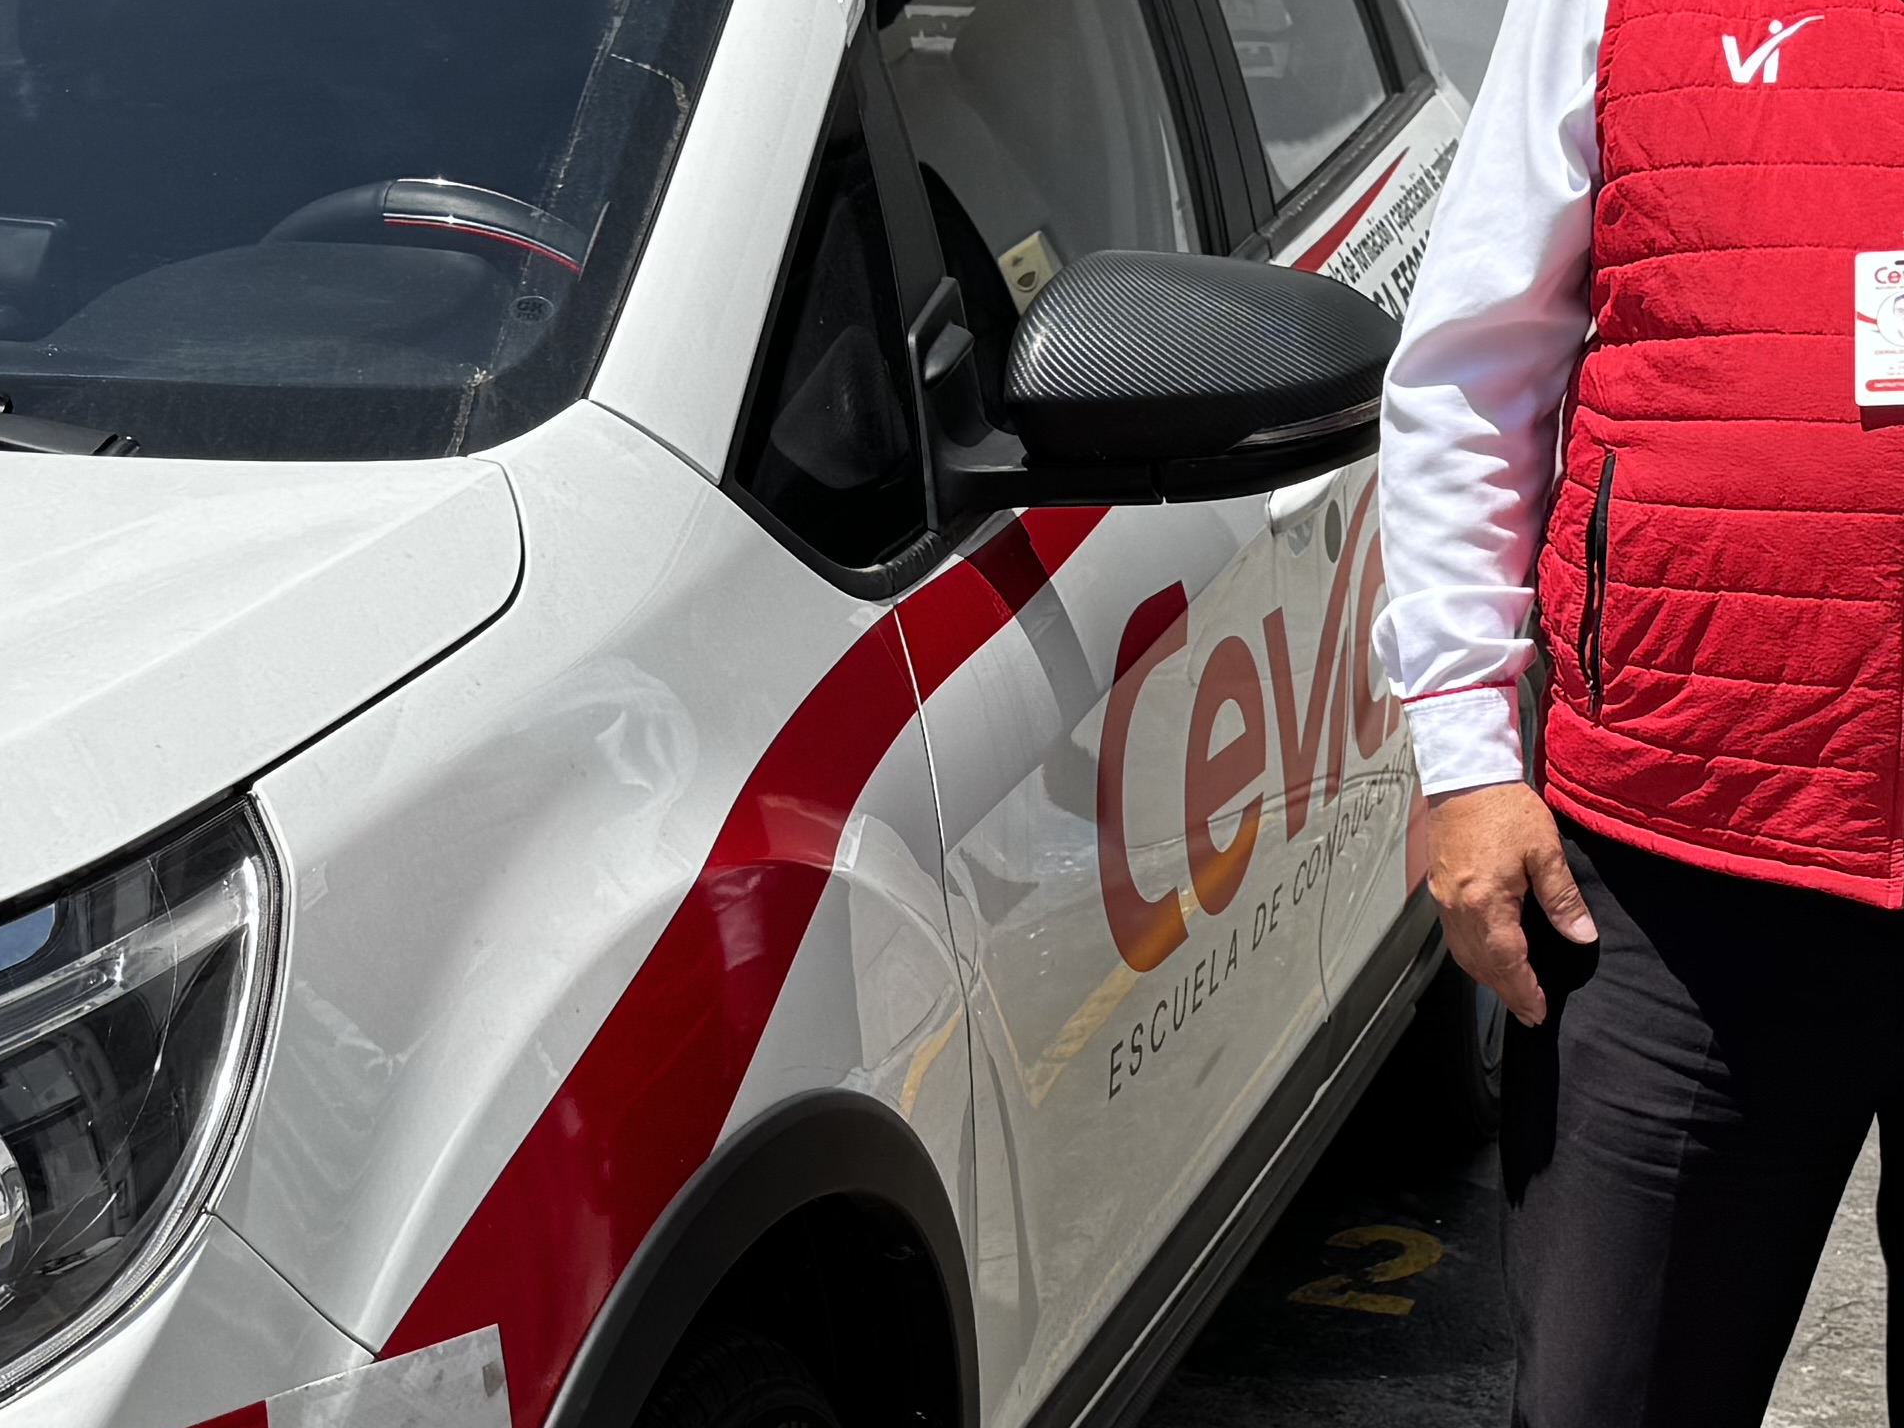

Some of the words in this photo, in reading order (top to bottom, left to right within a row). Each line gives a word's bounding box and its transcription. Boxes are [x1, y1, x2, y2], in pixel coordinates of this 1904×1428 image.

[1108, 928, 1238, 1101] ESCUELA
[1252, 882, 1283, 952] DE
[1286, 1225, 1444, 1316] 2
